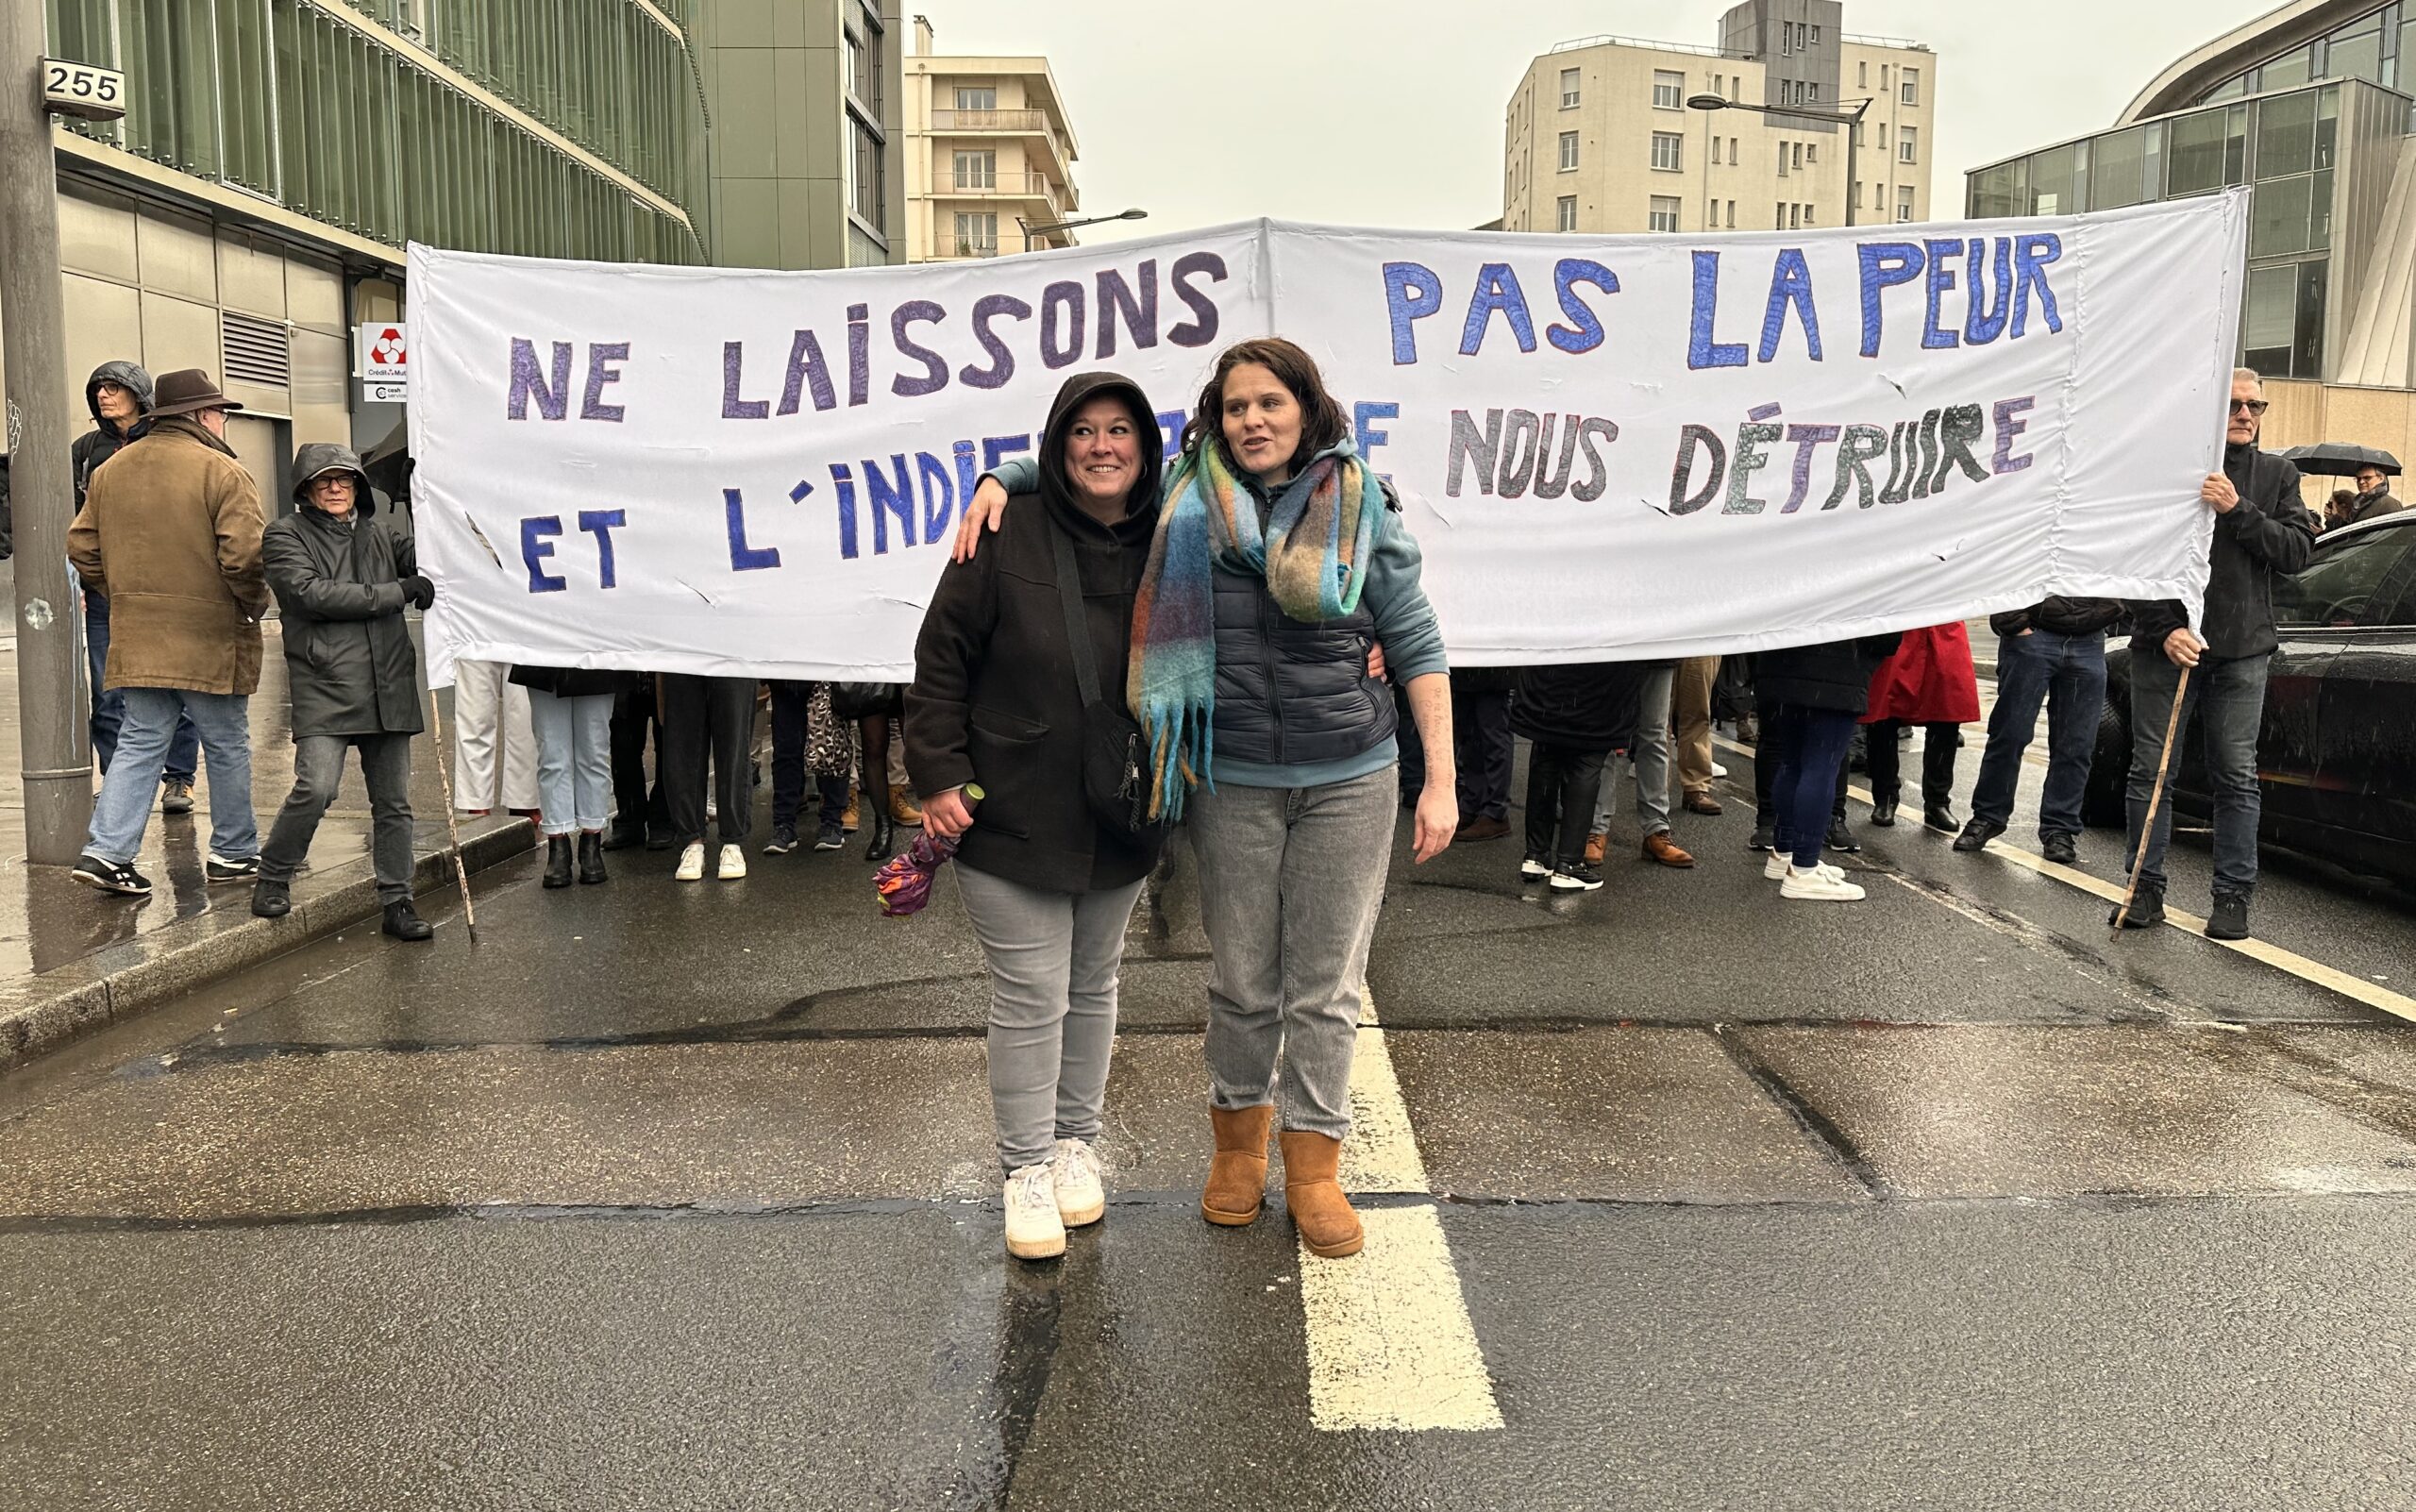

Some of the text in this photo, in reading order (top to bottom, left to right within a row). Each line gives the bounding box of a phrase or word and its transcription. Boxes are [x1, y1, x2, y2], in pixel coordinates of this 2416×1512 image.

[47, 67, 118, 101] 255
[508, 337, 631, 422] NE
[1383, 259, 1620, 365] PAS
[1686, 248, 1822, 370] LA
[1856, 233, 2063, 358] PEUR
[521, 509, 626, 593] ET
[1446, 409, 1619, 502] NOUS
[1669, 395, 2036, 516] DÉTRUIRE
